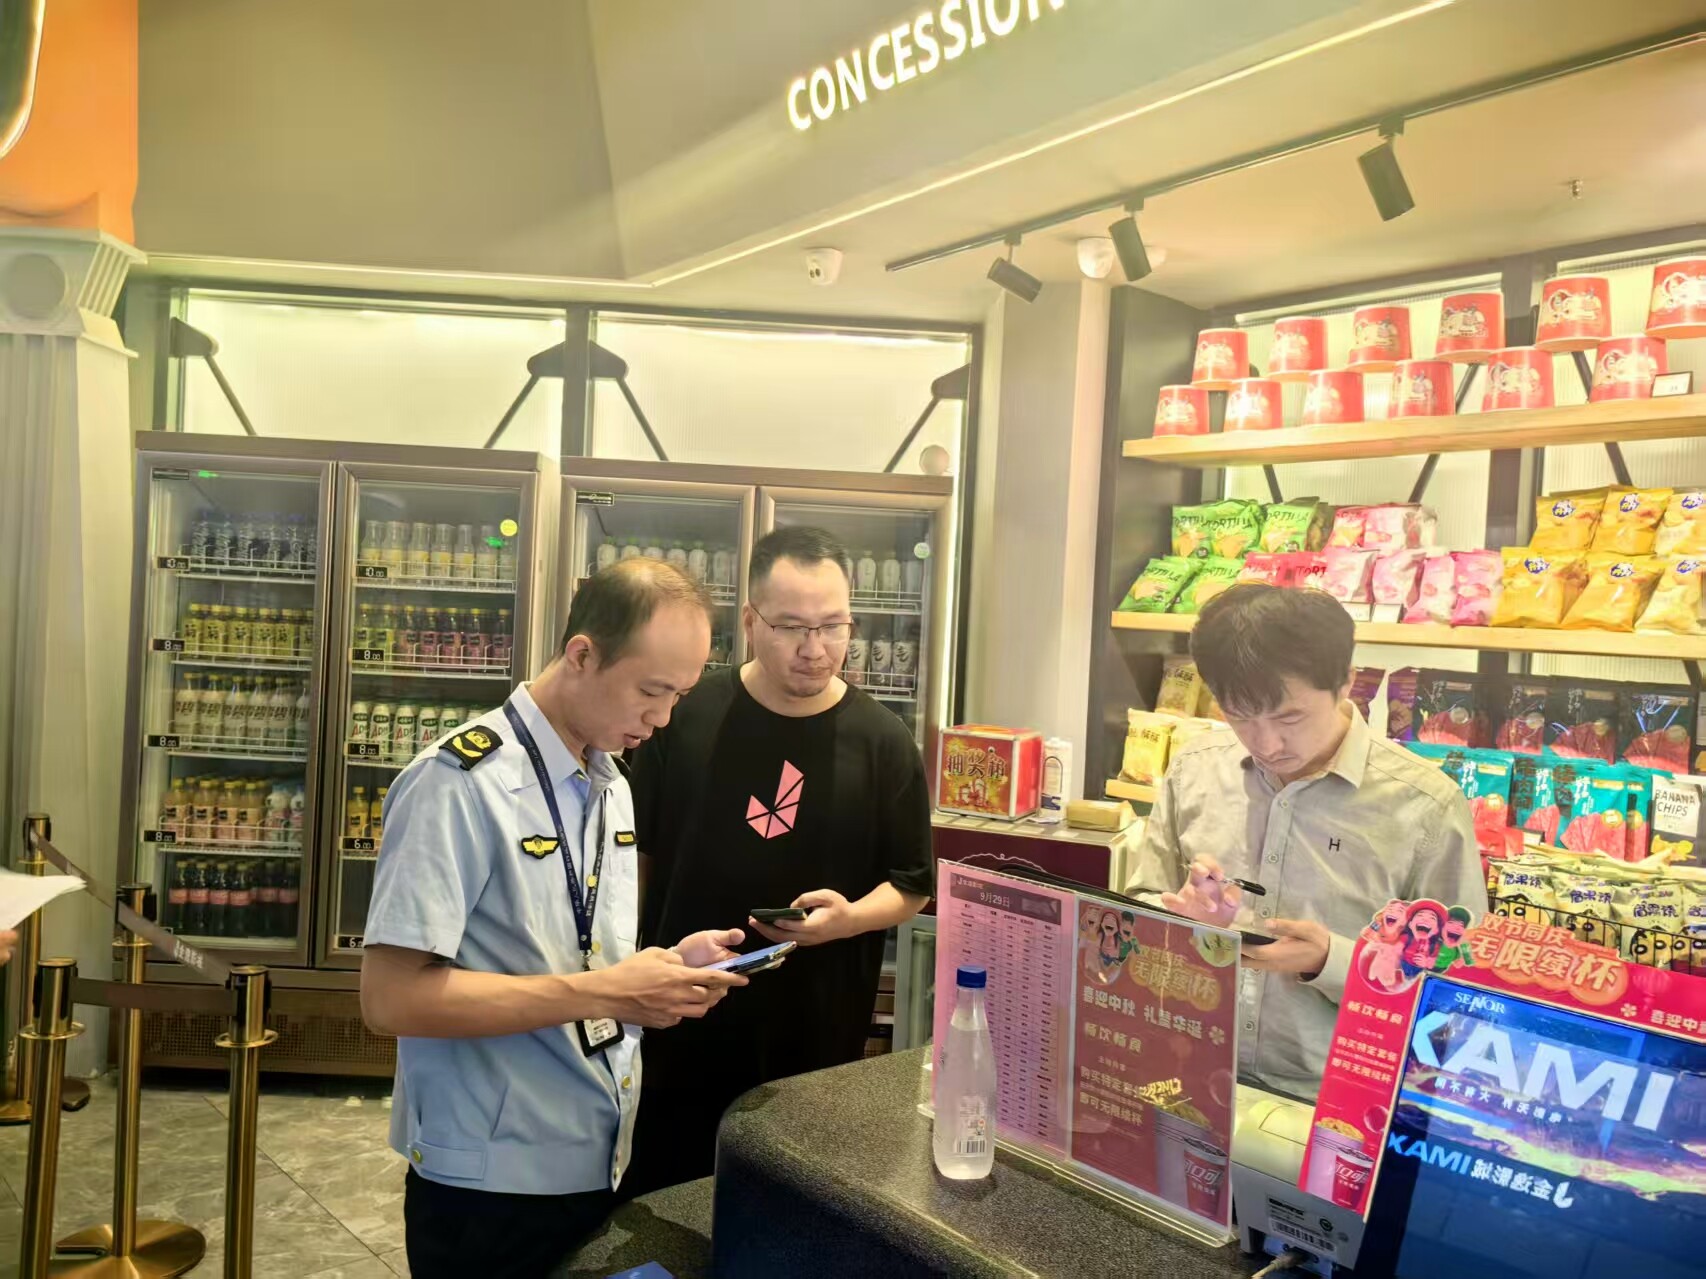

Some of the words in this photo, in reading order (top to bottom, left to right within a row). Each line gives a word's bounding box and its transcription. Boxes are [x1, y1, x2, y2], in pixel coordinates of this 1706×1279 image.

[787, 0, 1065, 131] CONCESSIO
[947, 748, 1007, 780] 抽奖箱
[1655, 788, 1696, 806] BANANA
[1657, 801, 1689, 818] CHIPS
[1328, 837, 1341, 851] H
[980, 892, 1010, 909] 9月29日
[1483, 914, 1572, 947] 双节同庆
[1471, 933, 1622, 990] 无限续杯
[1386, 1131, 1472, 1175] KAMI
